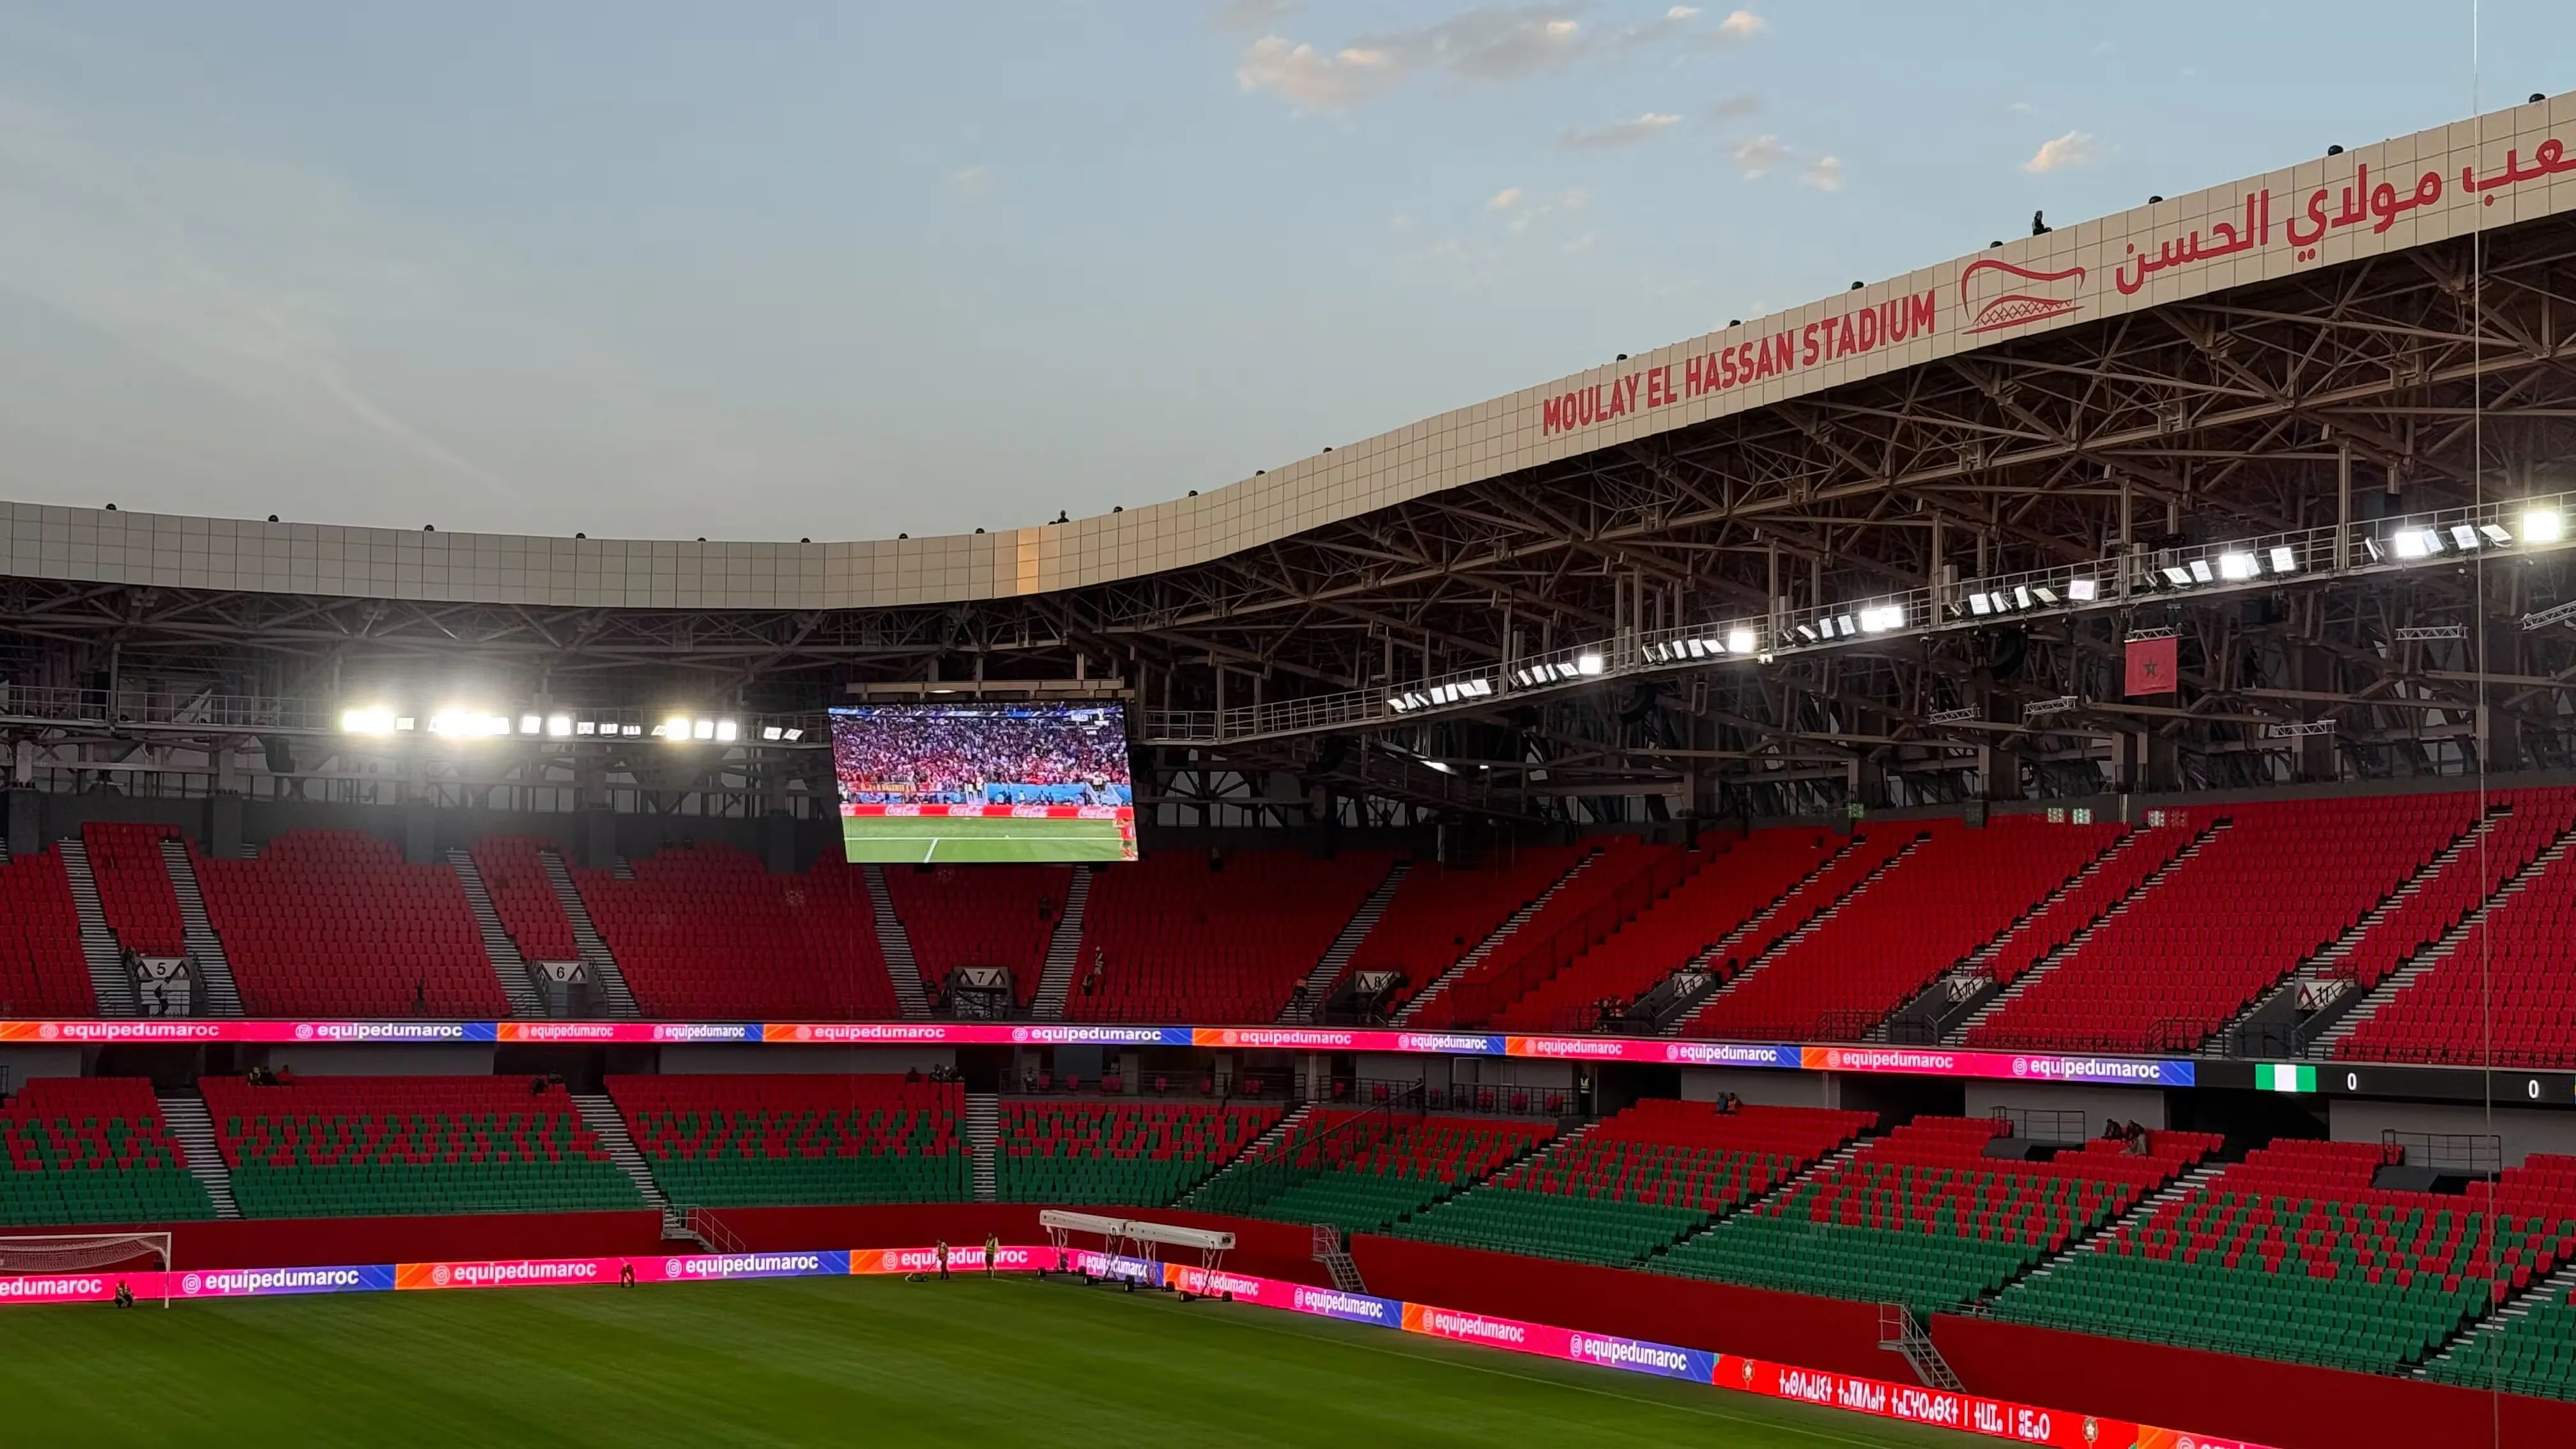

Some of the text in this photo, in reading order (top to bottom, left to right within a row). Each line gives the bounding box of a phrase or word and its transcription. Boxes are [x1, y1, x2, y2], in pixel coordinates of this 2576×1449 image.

[2287, 164, 2441, 261] مولاي
[2116, 189, 2269, 295] الحسن
[1543, 289, 1935, 436] MOULAY EL HASSAN STADIUM
[157, 962, 166, 976] 5
[556, 966, 565, 979] 6
[977, 971, 985, 983] 7
[63, 1022, 219, 1039] equipedumaroc
[318, 1023, 463, 1039] equipedumaroc
[530, 1024, 613, 1039] equipedumaroc
[665, 1025, 745, 1041] equipedumaroc
[815, 1025, 946, 1041] equipedumaroc
[1031, 1027, 1162, 1044] equipedumaroc
[1241, 1031, 1351, 1047] equipedumaroc
[1411, 1034, 1487, 1052] equipedumaroc
[1537, 1038, 1623, 1057] equipedumaroc
[1680, 1044, 1777, 1063] equipedumaroc
[1843, 1051, 1954, 1070] equipedumaroc
[2030, 1057, 2161, 1080] equipedumaroc
[2347, 1073, 2357, 1091] 0
[2528, 1079, 2540, 1098] 0
[454, 1261, 597, 1282] equipedumaroc
[685, 1254, 818, 1275] equipedumaroc
[205, 1268, 359, 1291] equipedumaroc
[1305, 1289, 1383, 1319] equipedumaroc
[1435, 1314, 1524, 1344] equipedumaroc
[1584, 1337, 1687, 1372] equipedumaroc
